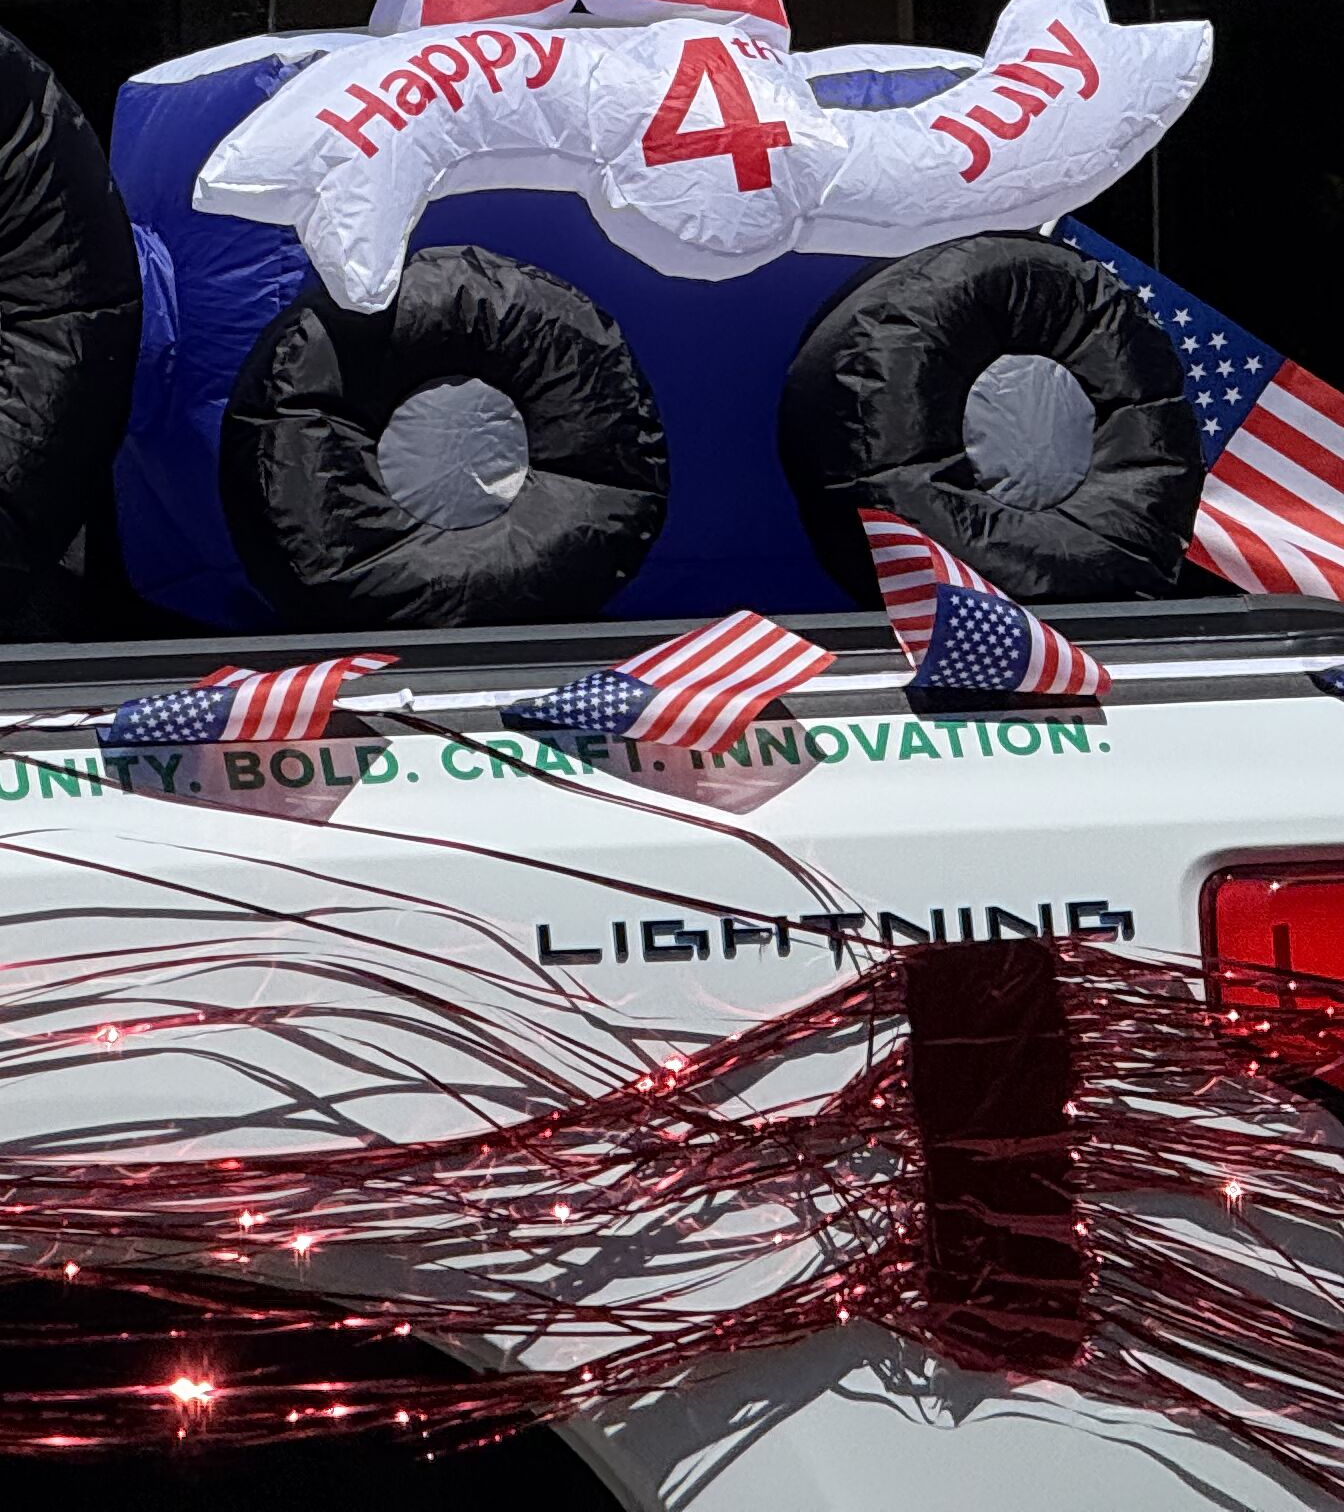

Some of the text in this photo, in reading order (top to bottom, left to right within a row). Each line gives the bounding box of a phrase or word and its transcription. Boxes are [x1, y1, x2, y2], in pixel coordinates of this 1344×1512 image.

[316, 26, 566, 159] Happy
[930, 18, 1100, 184] July
[224, 745, 419, 791] BOLD.
[440, 734, 666, 781] CRAFT.
[535, 899, 1135, 968] LIGHTNING
